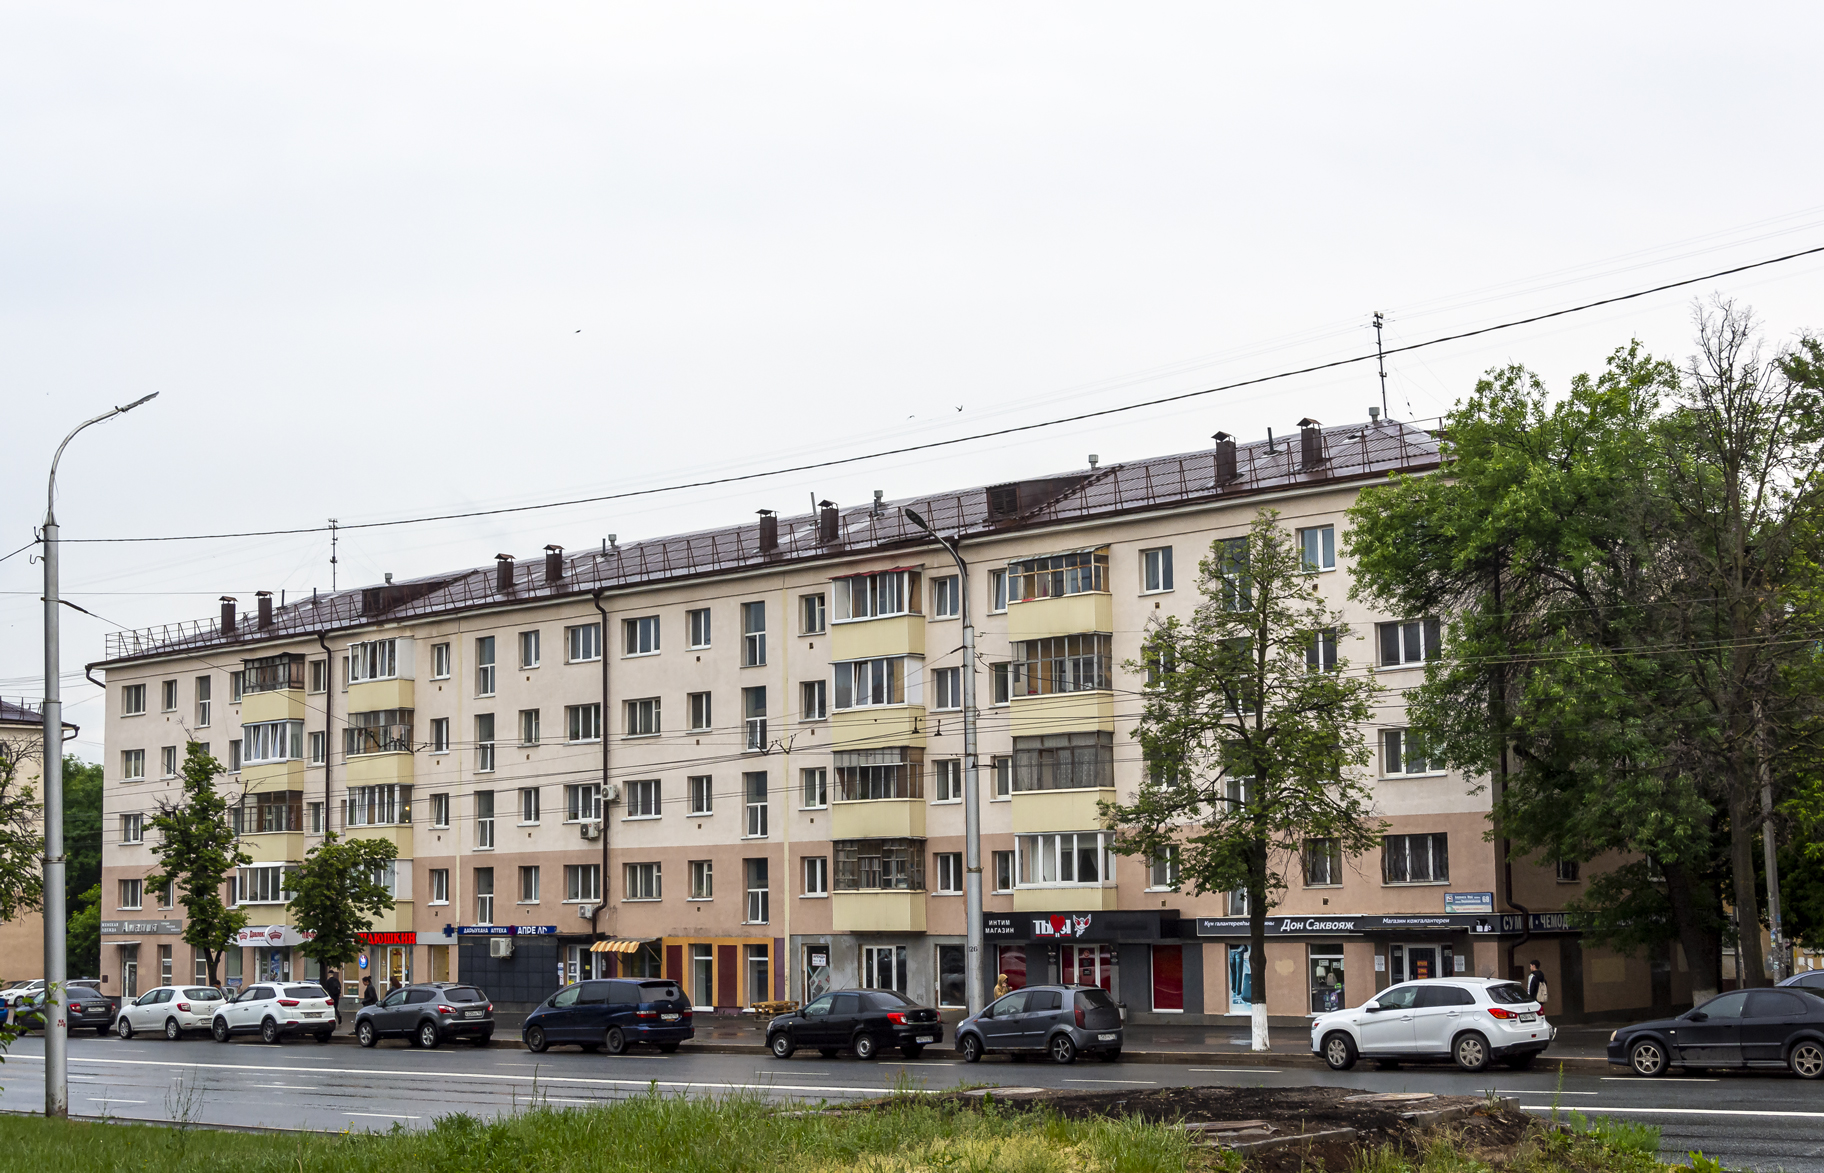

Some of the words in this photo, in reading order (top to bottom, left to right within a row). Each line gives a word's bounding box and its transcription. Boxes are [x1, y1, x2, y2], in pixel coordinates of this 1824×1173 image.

[1280, 919, 1304, 932] Дон
[1305, 919, 1355, 930] Саквояж
[1503, 915, 1533, 930] СУМИ
[1540, 914, 1569, 929] ЧЕМОД
